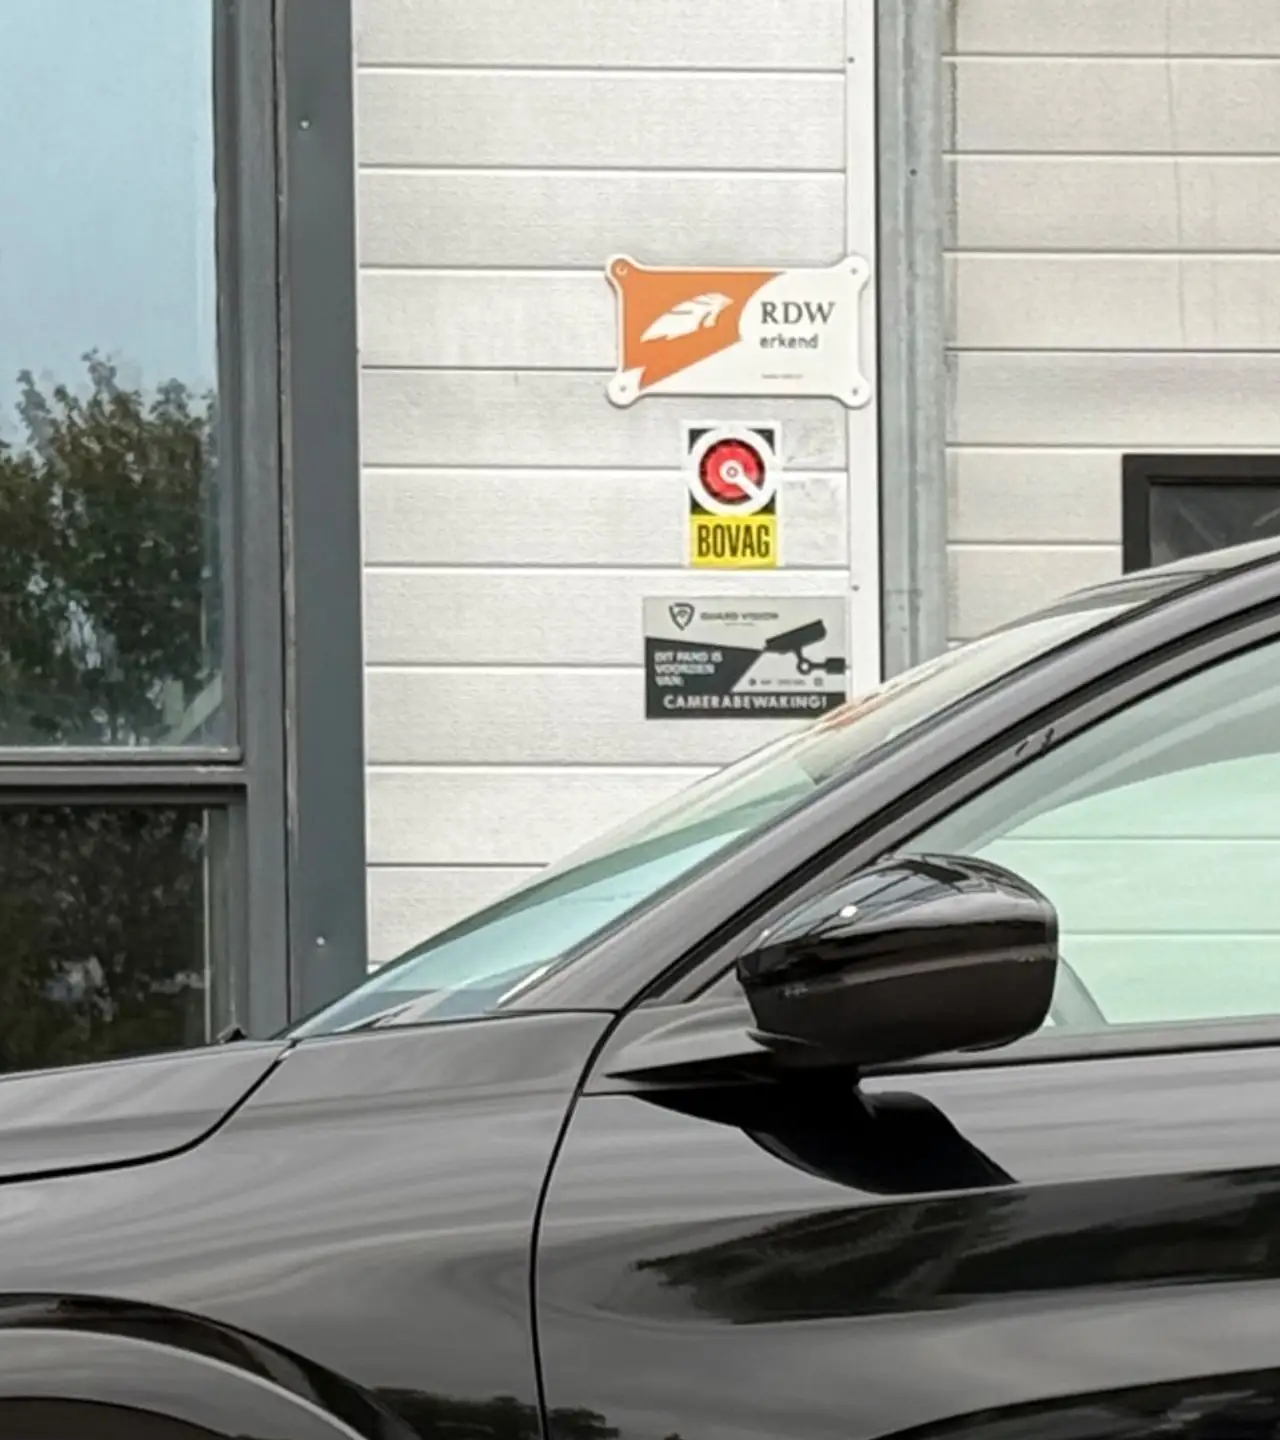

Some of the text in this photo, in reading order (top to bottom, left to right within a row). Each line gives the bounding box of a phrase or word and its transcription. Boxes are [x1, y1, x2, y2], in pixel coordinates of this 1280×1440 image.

[760, 301, 836, 325] RDW
[760, 334, 818, 350] erkend
[697, 523, 770, 558] BOVAG
[663, 692, 827, 710] CAMERABEWAKING!
